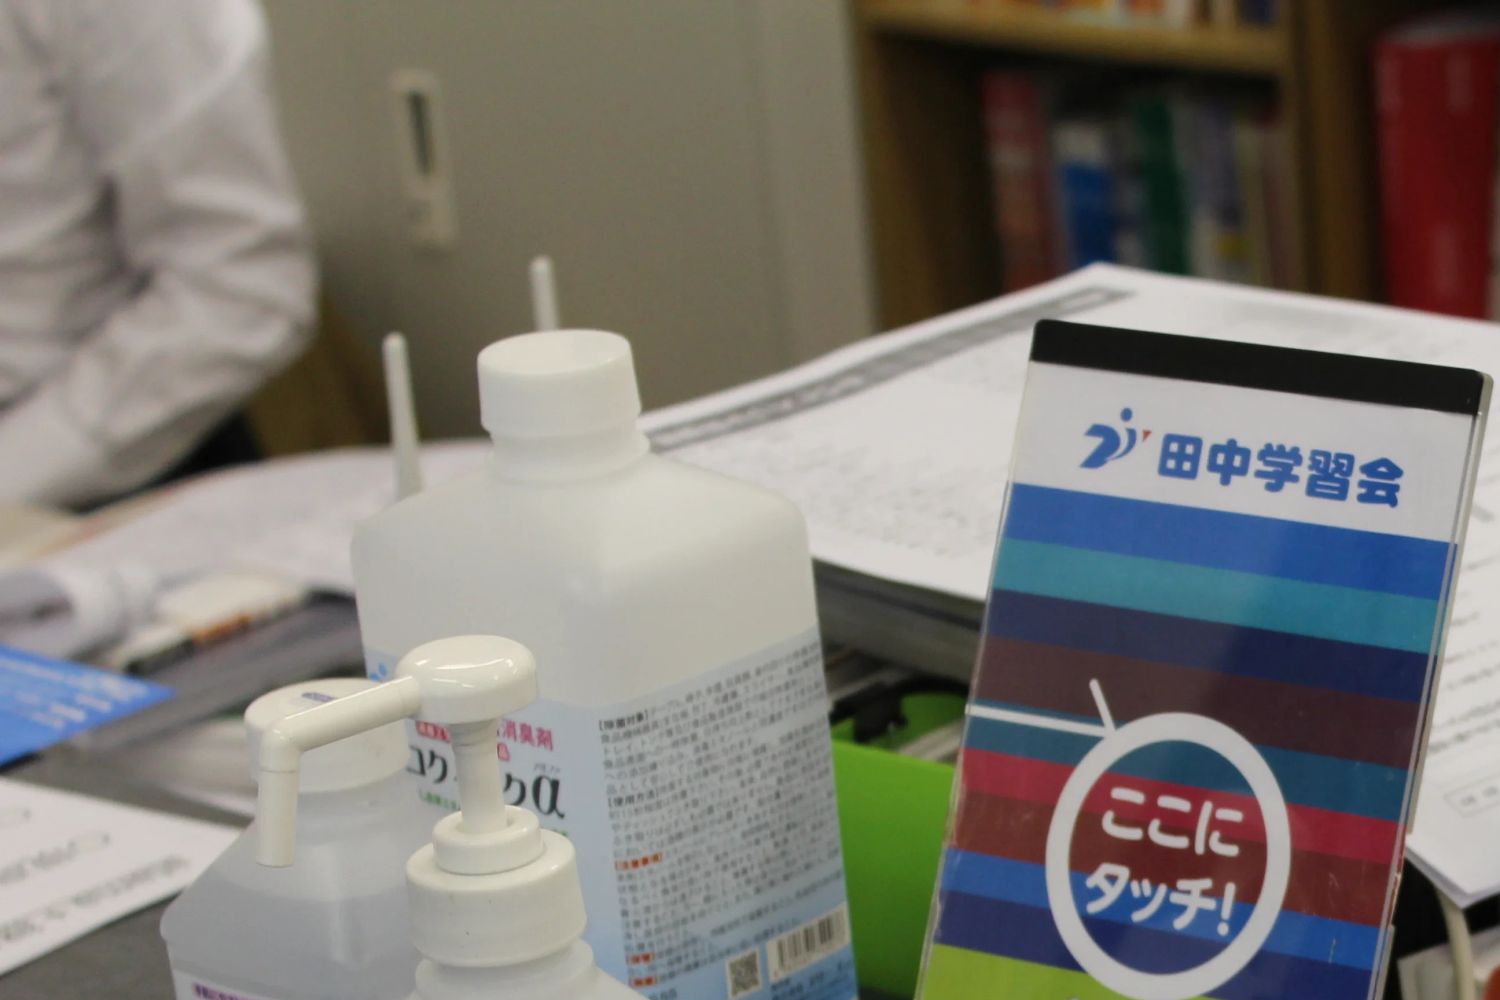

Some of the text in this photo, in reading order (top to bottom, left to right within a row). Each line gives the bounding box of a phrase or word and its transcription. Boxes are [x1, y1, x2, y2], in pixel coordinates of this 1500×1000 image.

[1157, 432, 1404, 509] 田中学習会
[1101, 787, 1243, 857] ここに
[1084, 861, 1237, 936] タッチ!
